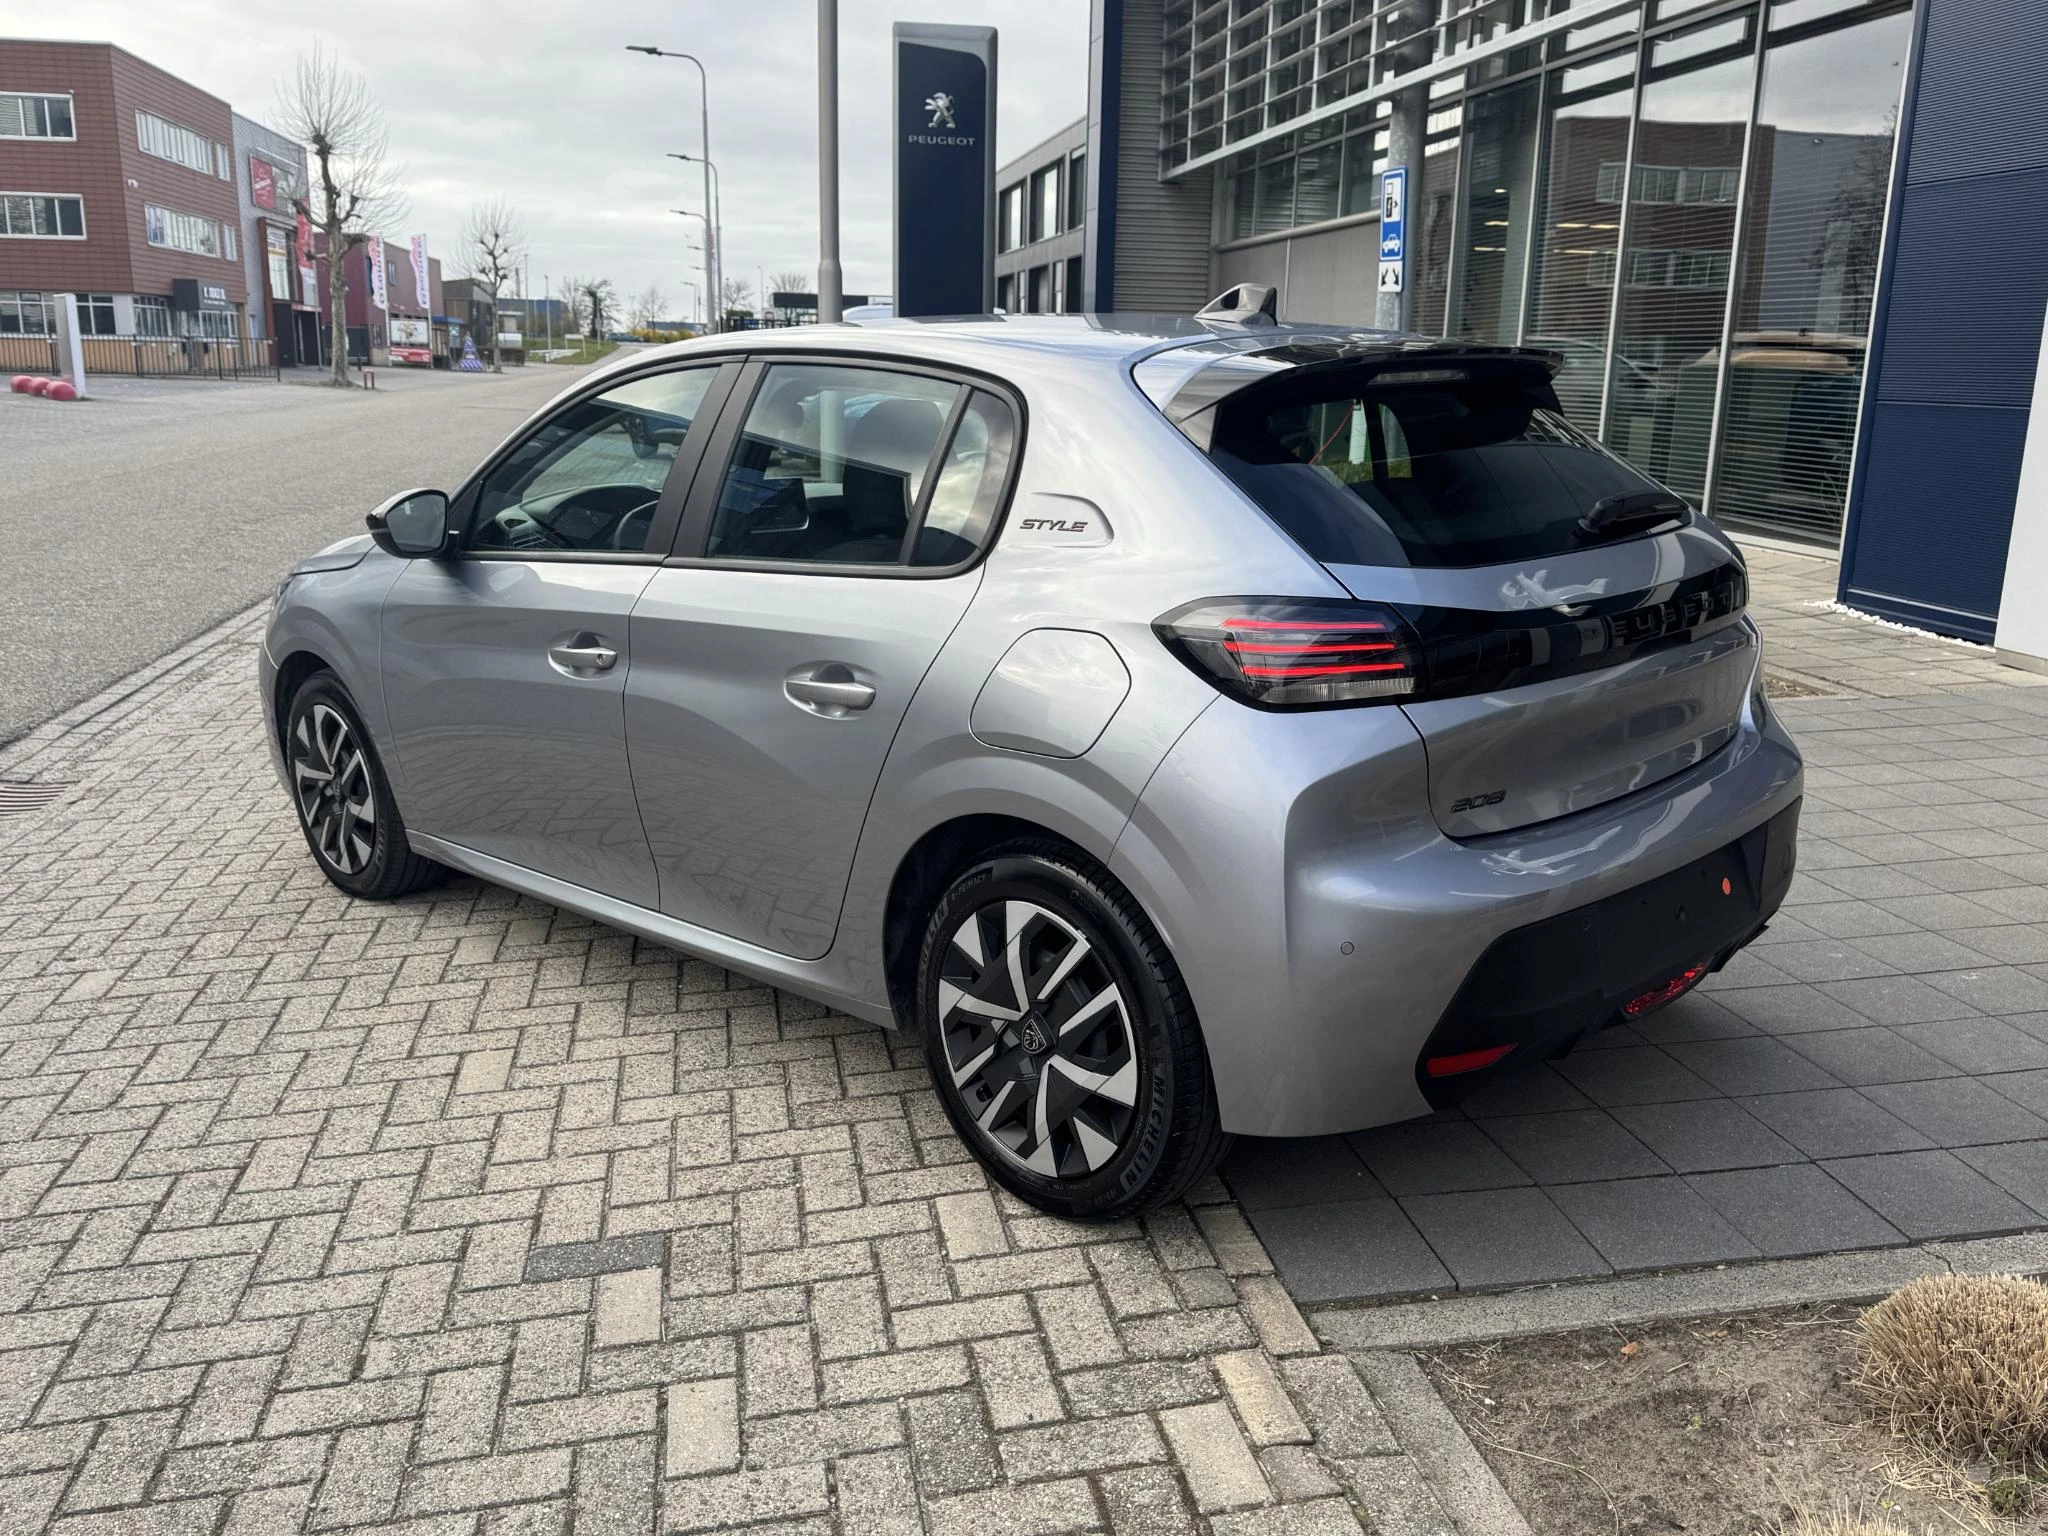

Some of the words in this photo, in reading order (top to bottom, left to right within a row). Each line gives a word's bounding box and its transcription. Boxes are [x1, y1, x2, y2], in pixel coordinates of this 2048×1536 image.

[908, 135, 976, 146] PEUGEOT
[1020, 519, 1088, 532] STYLE
[1450, 789, 1506, 813] 208
[1124, 1074, 1166, 1186] MICHELIN
